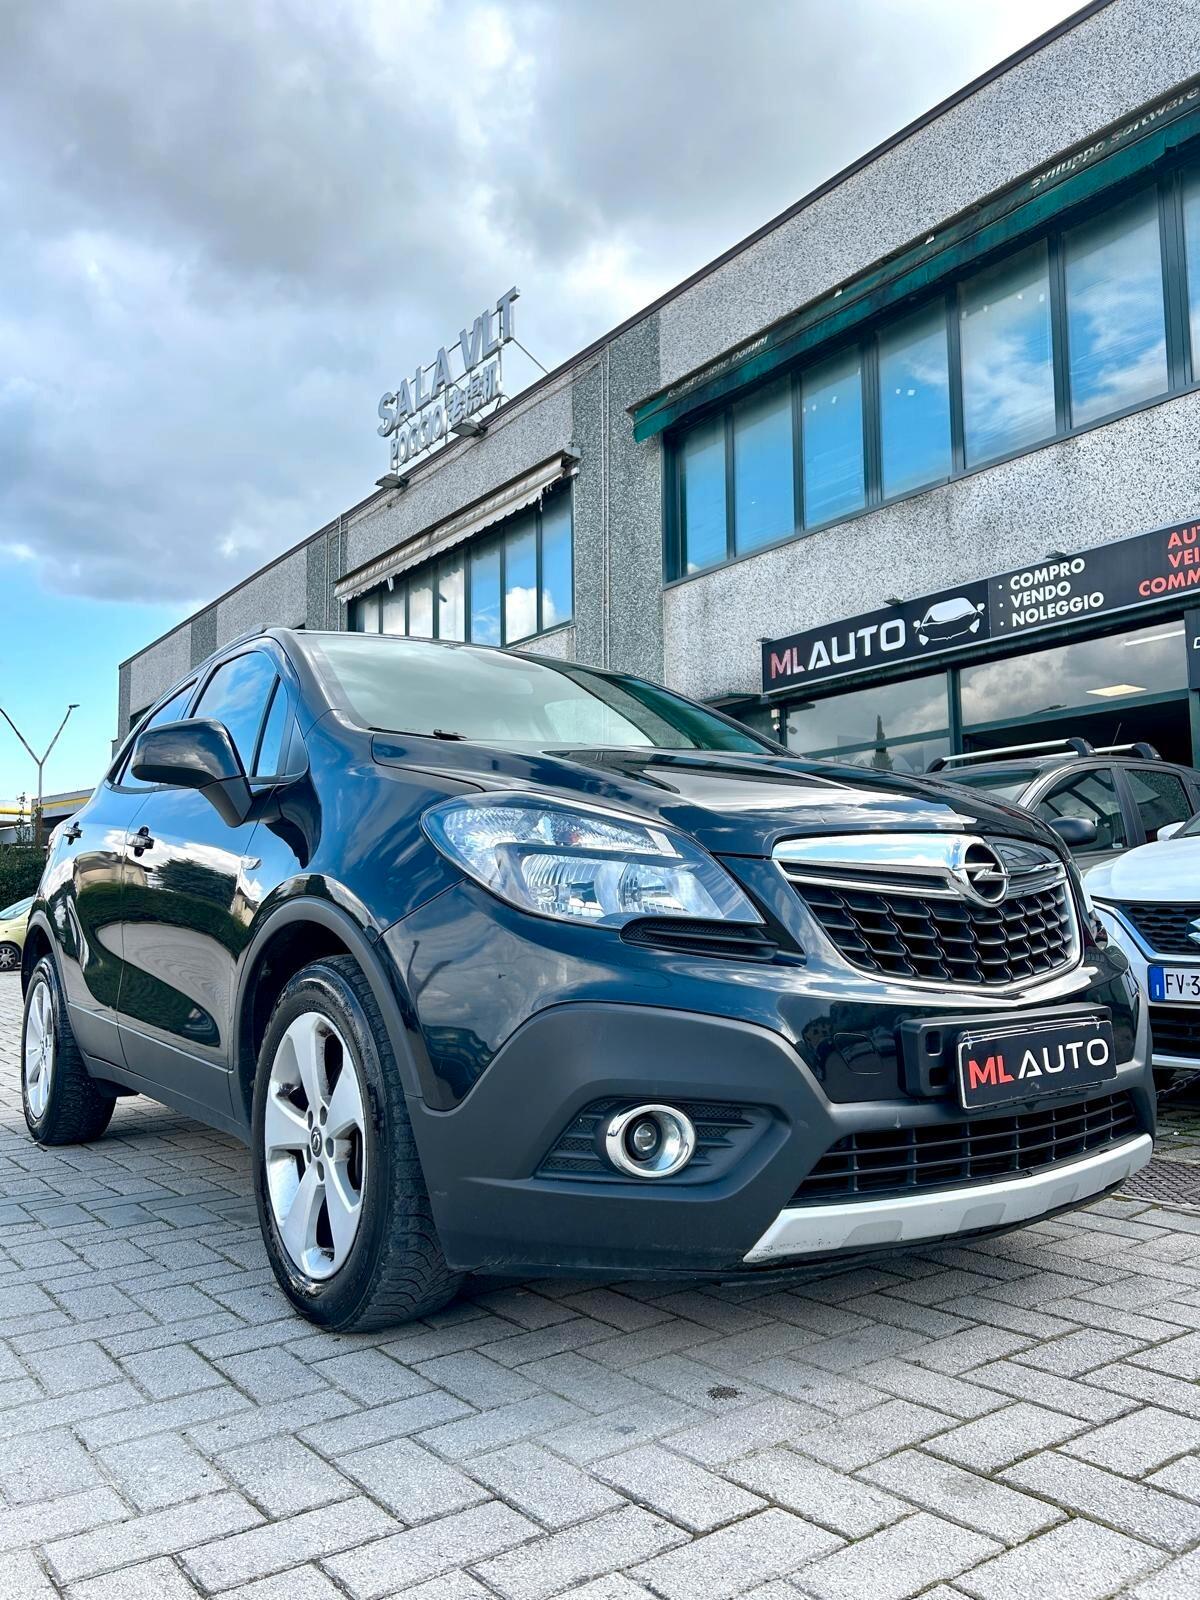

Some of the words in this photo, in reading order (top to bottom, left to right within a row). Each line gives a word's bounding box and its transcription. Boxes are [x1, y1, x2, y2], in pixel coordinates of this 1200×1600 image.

[1030, 141, 1105, 189] Sviluppo
[377, 346, 453, 437] SALA
[459, 286, 520, 373] VLT
[390, 404, 448, 470] POGGIO
[1168, 525, 1200, 549] AU
[1010, 557, 1086, 590] COMPRO
[1010, 581, 1072, 609] VENDO
[1011, 591, 1105, 628] NOLEGGIO
